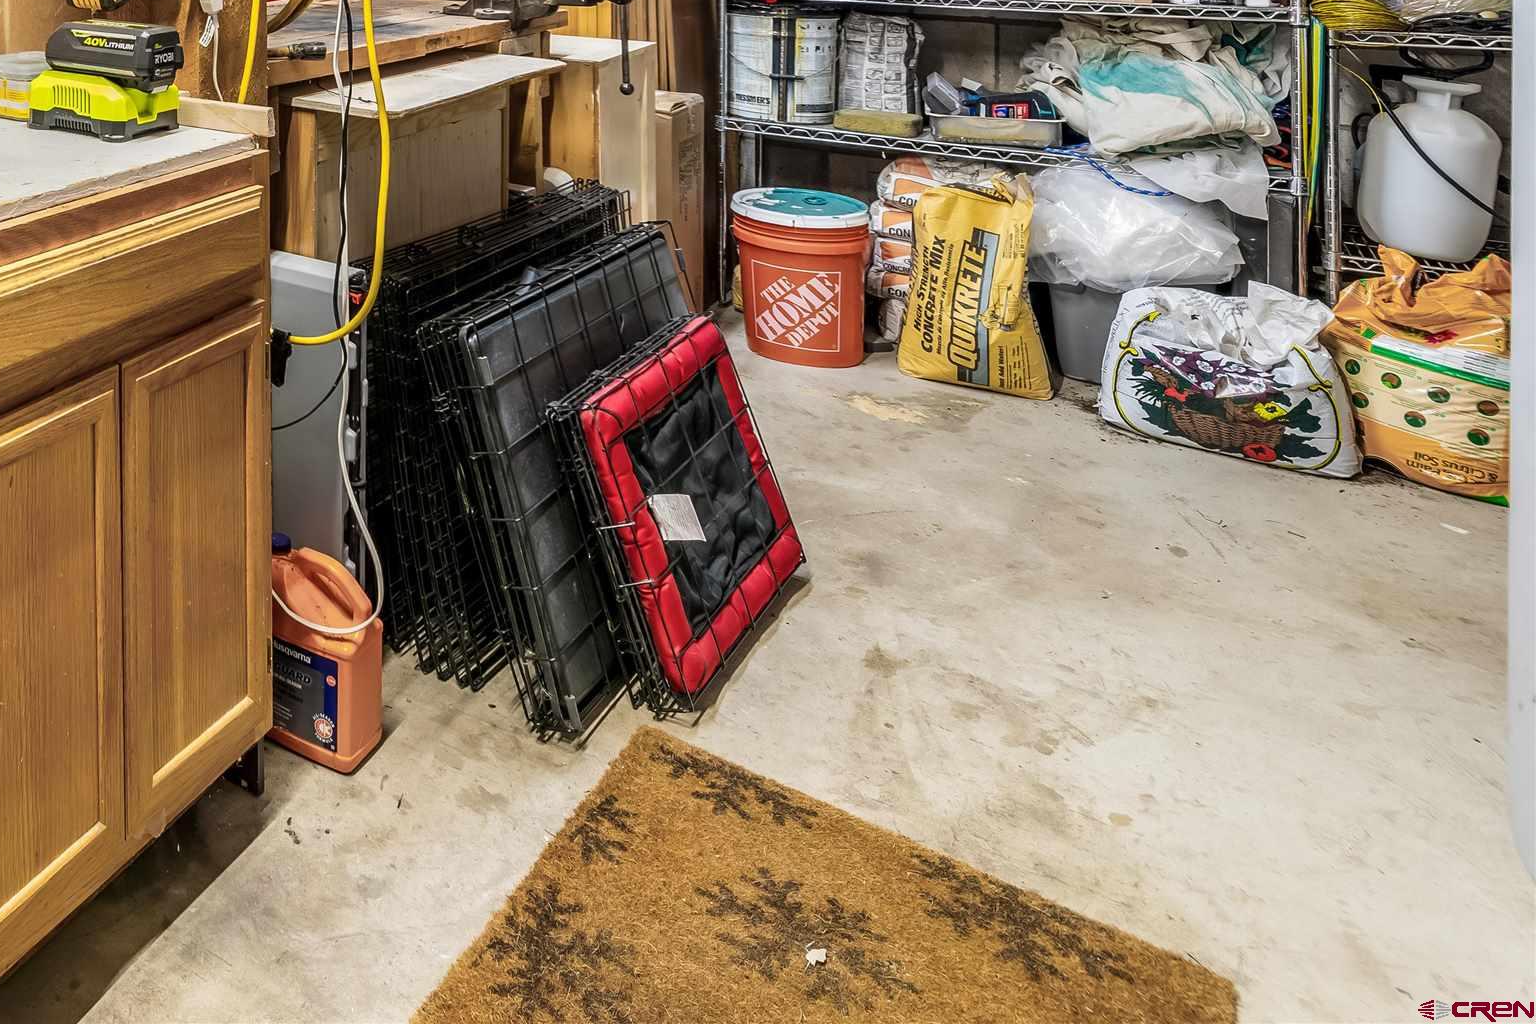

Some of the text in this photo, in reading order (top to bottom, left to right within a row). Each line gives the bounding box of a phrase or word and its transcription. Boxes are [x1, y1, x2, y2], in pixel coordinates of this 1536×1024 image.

[154, 51, 175, 65] RYOBI
[756, 272, 840, 342] HOME
[760, 276, 796, 304] THE
[914, 246, 929, 332] HIGH STRENGTH
[920, 235, 946, 353] CONCRETE MIX
[948, 240, 987, 371] QUIKRETE
[785, 302, 840, 347] DEPOT
[1413, 451, 1439, 467] Soil
[1441, 460, 1485, 479] Citrus
